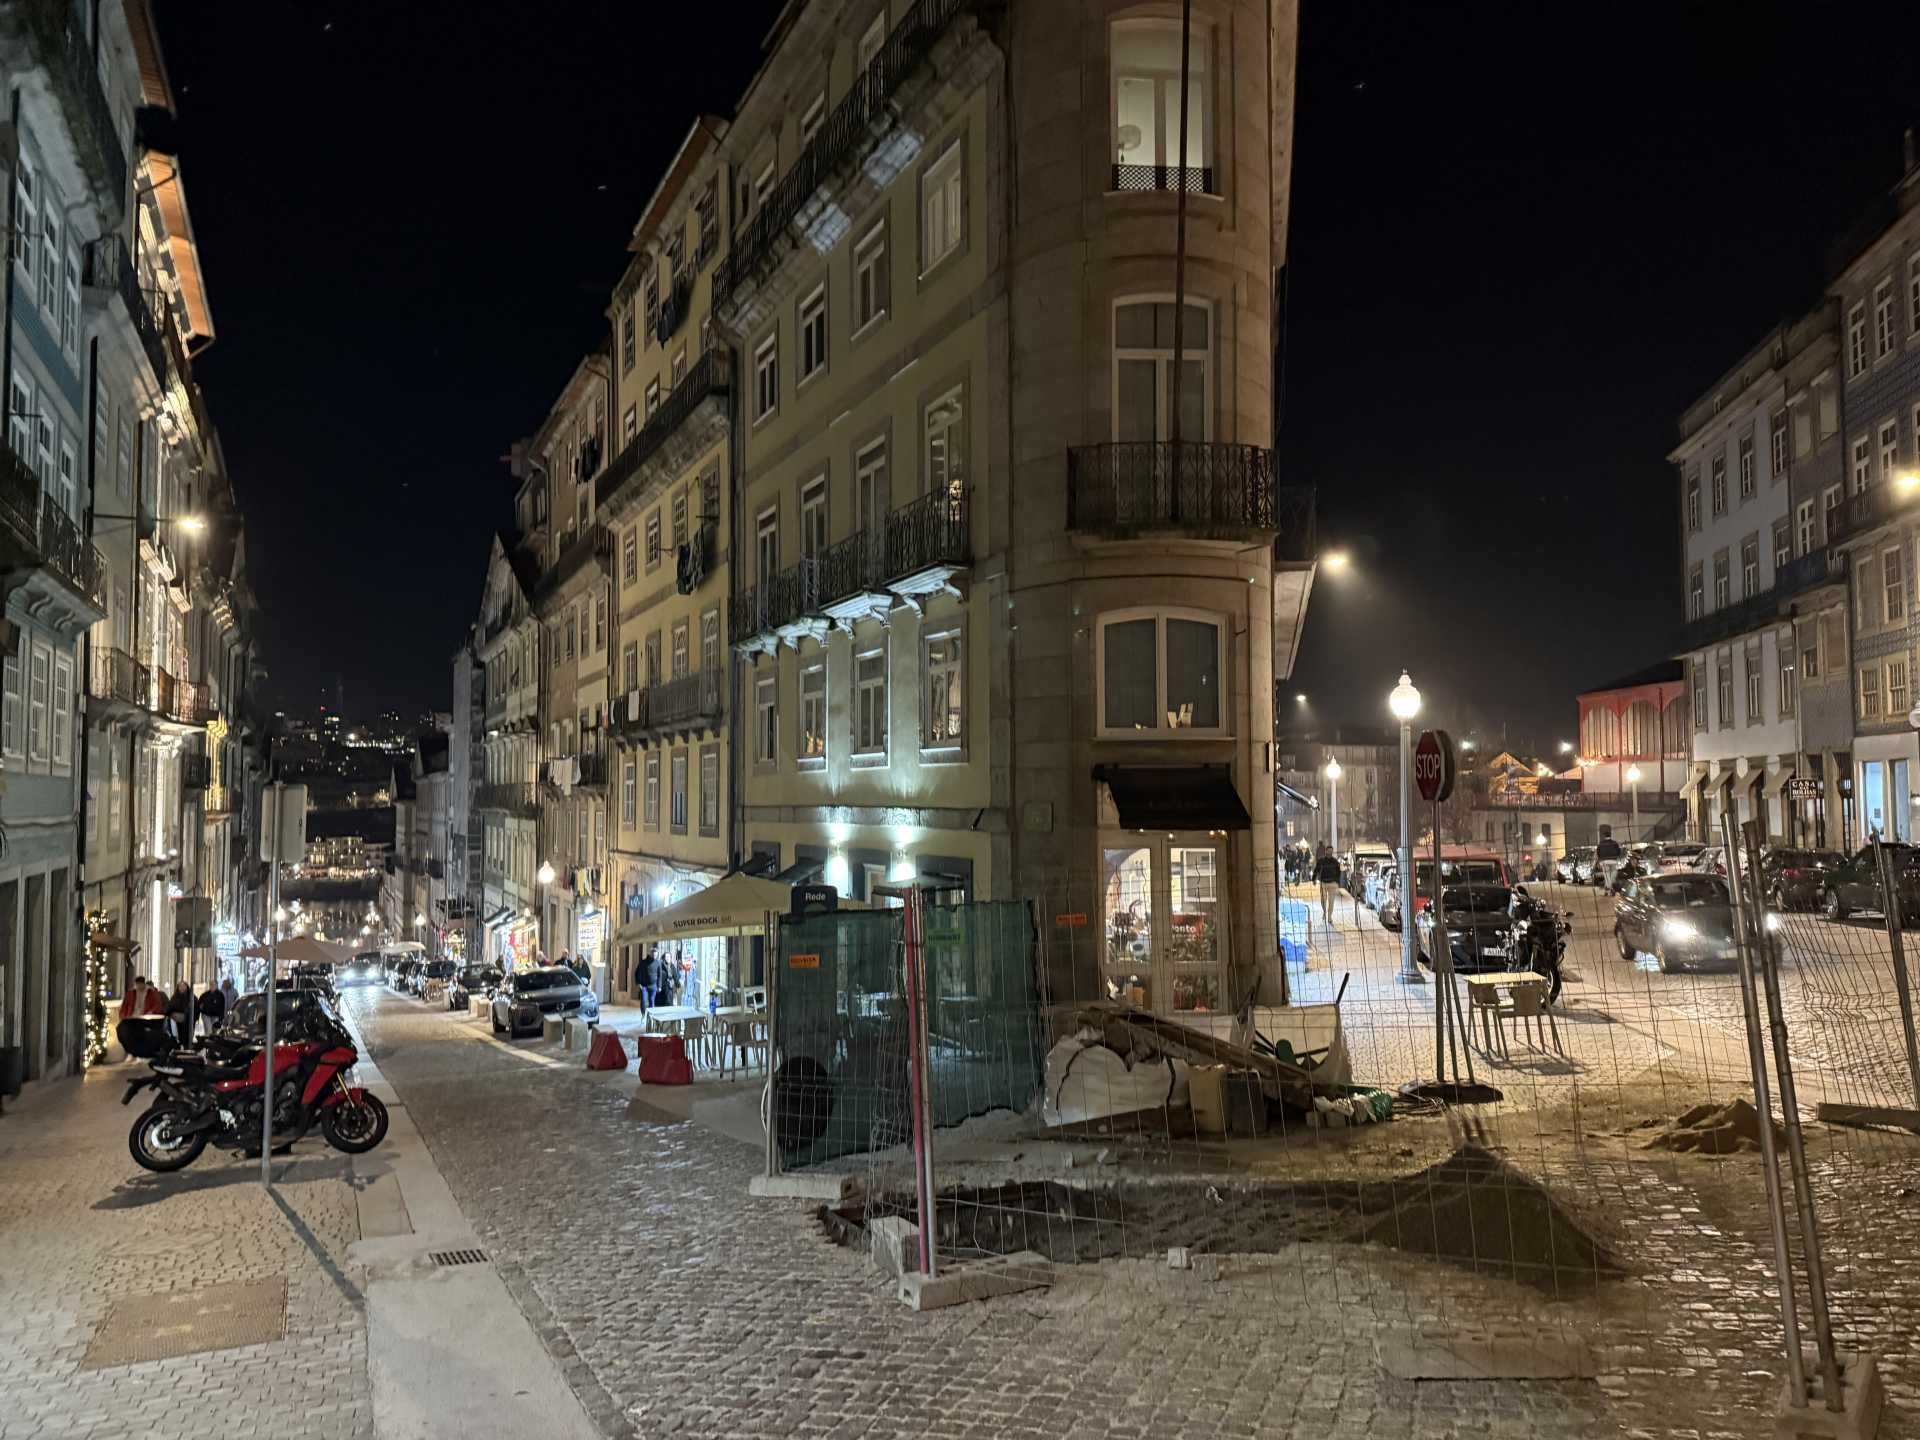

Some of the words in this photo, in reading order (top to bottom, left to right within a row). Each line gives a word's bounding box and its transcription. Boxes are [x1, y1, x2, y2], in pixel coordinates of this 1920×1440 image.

[1417, 754, 1440, 778] STOP
[805, 892, 826, 901] Rede
[672, 919, 696, 929] SUPER
[697, 916, 718, 926] BOCK
